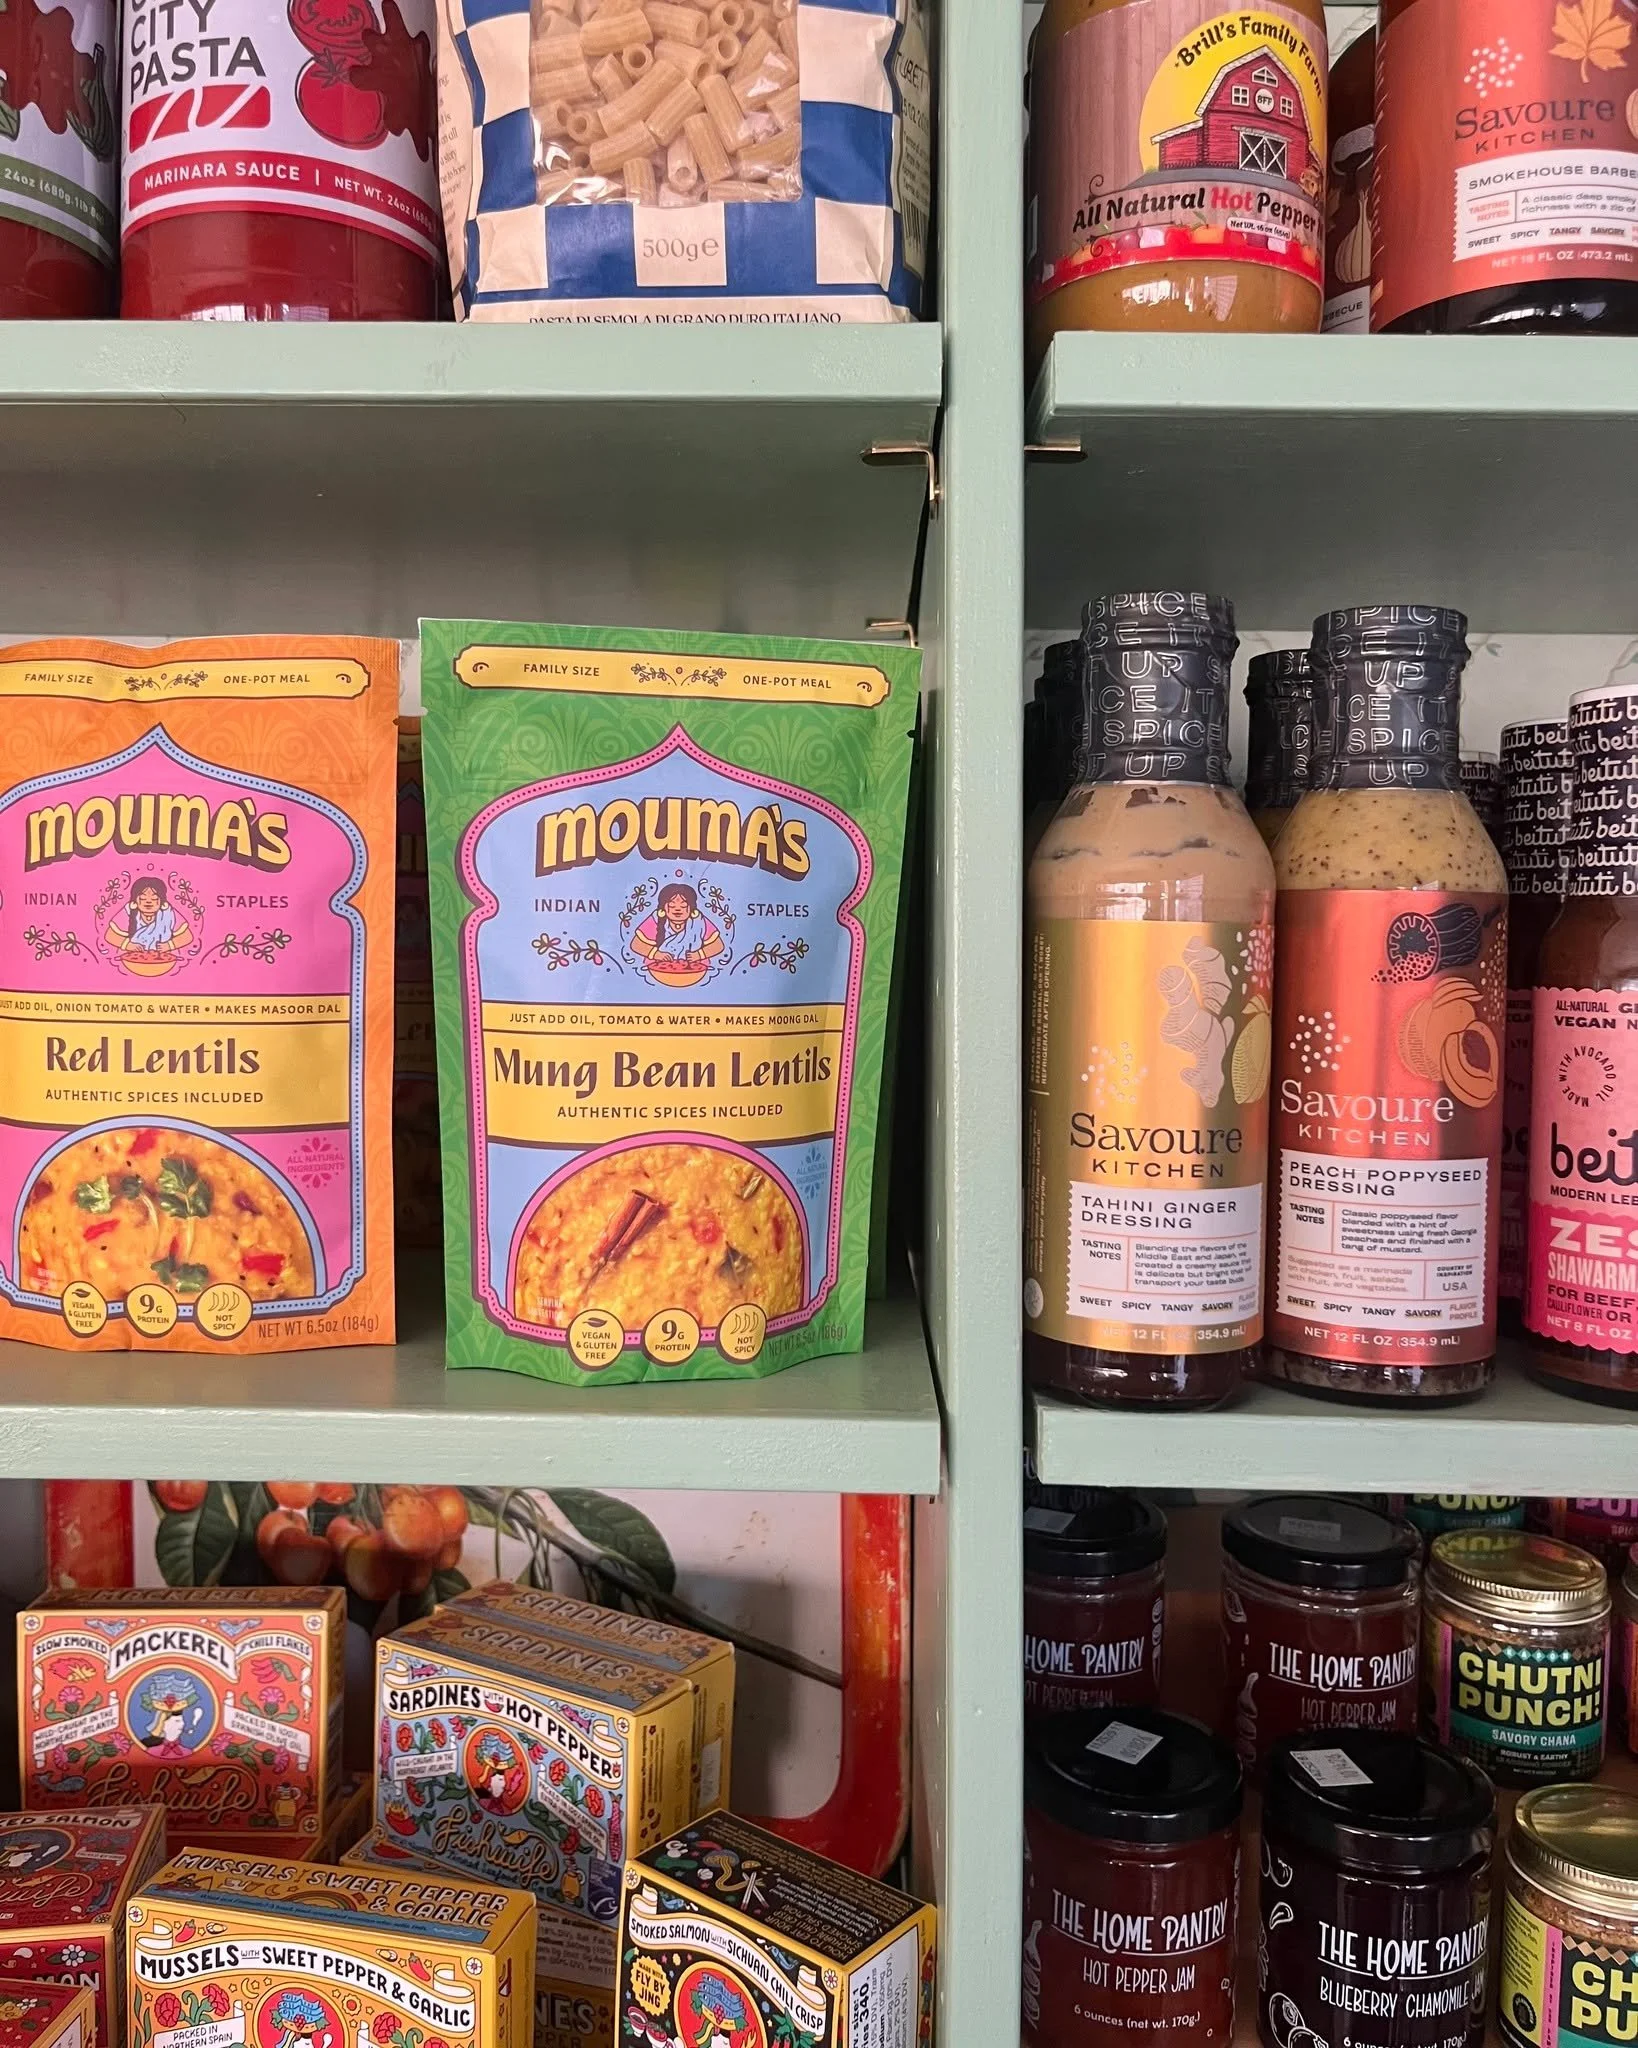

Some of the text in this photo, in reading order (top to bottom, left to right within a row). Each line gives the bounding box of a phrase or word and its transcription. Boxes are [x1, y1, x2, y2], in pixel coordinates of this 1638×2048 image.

[131, 0, 217, 56] CITY
[1177, 16, 1323, 97] Brill's Family Farm
[131, 37, 266, 105] PASTA
[1455, 100, 1616, 140] Savoure
[1476, 128, 1596, 154] KITCHEN
[144, 162, 300, 191] MARINARA SAUCE
[334, 175, 360, 193] NET
[1469, 165, 1583, 189] SMOKEHOUSE
[1073, 186, 1316, 233] All Natural Hot Pepper
[24, 673, 94, 685] FAMILY SIZE
[223, 673, 310, 685] ONE-POT MEAL
[523, 663, 600, 677] FAMILY SIZE
[743, 674, 832, 689] ONE-POT MEAL
[25, 893, 289, 910] INDIAN STAPLES
[534, 898, 809, 918] INDIAN STAPLES
[34, 1002, 341, 1015] OIL, ONION TOMATO WATER MAKES MASOOR DAL
[509, 1012, 801, 1026] JUST ADD OIL, TOMATO WATER MAKES MOONG
[1554, 1015, 1616, 1029] VEGAN
[46, 1036, 261, 1075] Red Lentils
[1574, 1045, 1616, 1080] AVOCADO
[493, 1046, 831, 1099] Mung Bean Lentils
[45, 1089, 264, 1104] AUTHENTIC SPICES INCLUDED
[1281, 1079, 1454, 1123] Savoure
[557, 1103, 783, 1119] AUTHENTIC SPICES INCLUDED
[1070, 1112, 1243, 1155] Savoure
[1299, 1124, 1431, 1146] KITCHEN
[1092, 1158, 1225, 1178] KITCHEN
[1290, 1161, 1481, 1182] PEACH POPPYSEED
[1290, 1176, 1395, 1196] DRESSING
[1550, 1185, 1606, 1203] MODERN
[1081, 1195, 1237, 1214] TAHINI GINGER
[1290, 1203, 1325, 1215] TASTING
[1081, 1210, 1192, 1229] DRESSING
[1296, 1214, 1325, 1224] NOTES
[1081, 1239, 1122, 1250] TASTING
[1089, 1250, 1121, 1261] NOTES
[1442, 1281, 1468, 1292] USA
[1547, 1284, 1578, 1301] FOR
[1079, 1296, 1193, 1312] SWEET SPICY TANGY
[1323, 1302, 1442, 1318] SPICY TANGY SAVORY
[137, 1314, 170, 1325] PROTEIN
[213, 1321, 236, 1331] SPICY
[258, 1315, 380, 1338] NET (184g)
[1547, 1315, 1571, 1329] NET
[1605, 1309, 1632, 1324] OR
[582, 1331, 611, 1340] VEGAN
[736, 1335, 754, 1344] NOT
[1304, 1325, 1330, 1339] NET
[583, 1340, 617, 1350] GLUTEN
[654, 1342, 691, 1353] PROTEIN
[585, 1351, 607, 1361] FREE
[516, 1591, 680, 1644] SARDINES
[36, 1636, 108, 1655] SLOW SMOKED
[115, 1631, 229, 1668] MACKEREL
[276, 1636, 311, 1657] FLAKES
[462, 1625, 635, 1680] SARDINES
[1081, 1637, 1145, 1674] PANTRY
[1269, 1641, 1417, 1692] THE HOME PANTRY
[1458, 1651, 1602, 1695] CHUTNI
[1458, 1683, 1601, 1727] PUNCH!
[388, 1684, 613, 1779] SARDINES HOT PEPPER
[1492, 1729, 1576, 1746] SAVORY CHANA
[47, 1814, 132, 1828] SALMON
[170, 1852, 508, 1911] MUSSELS SWEET PEPPER
[396, 1901, 498, 1927] GARLIC
[1052, 1888, 1228, 1953] THE HOME PANTRY
[1319, 1920, 1358, 1967] THE
[1367, 1935, 1429, 1981] HOME
[1435, 1916, 1489, 1970] PANTRY
[631, 1918, 668, 1939] SMOKED
[669, 1924, 711, 1943] SALMON
[727, 1940, 769, 1983] SICHUAN
[771, 1972, 795, 2011] CHILI
[795, 2003, 824, 2031] CRISP
[635, 1970, 666, 1995] FLY BY
[1083, 1957, 1195, 1994] HOT PEPPER JAM
[140, 1945, 471, 2027] MUSSELS WITH SWEET PEPPER GARLIC
[638, 1988, 661, 2008] JING
[1320, 1976, 1469, 2018] BLUEBERRY CHAMOMILE
[173, 2027, 204, 2041] PACKED
